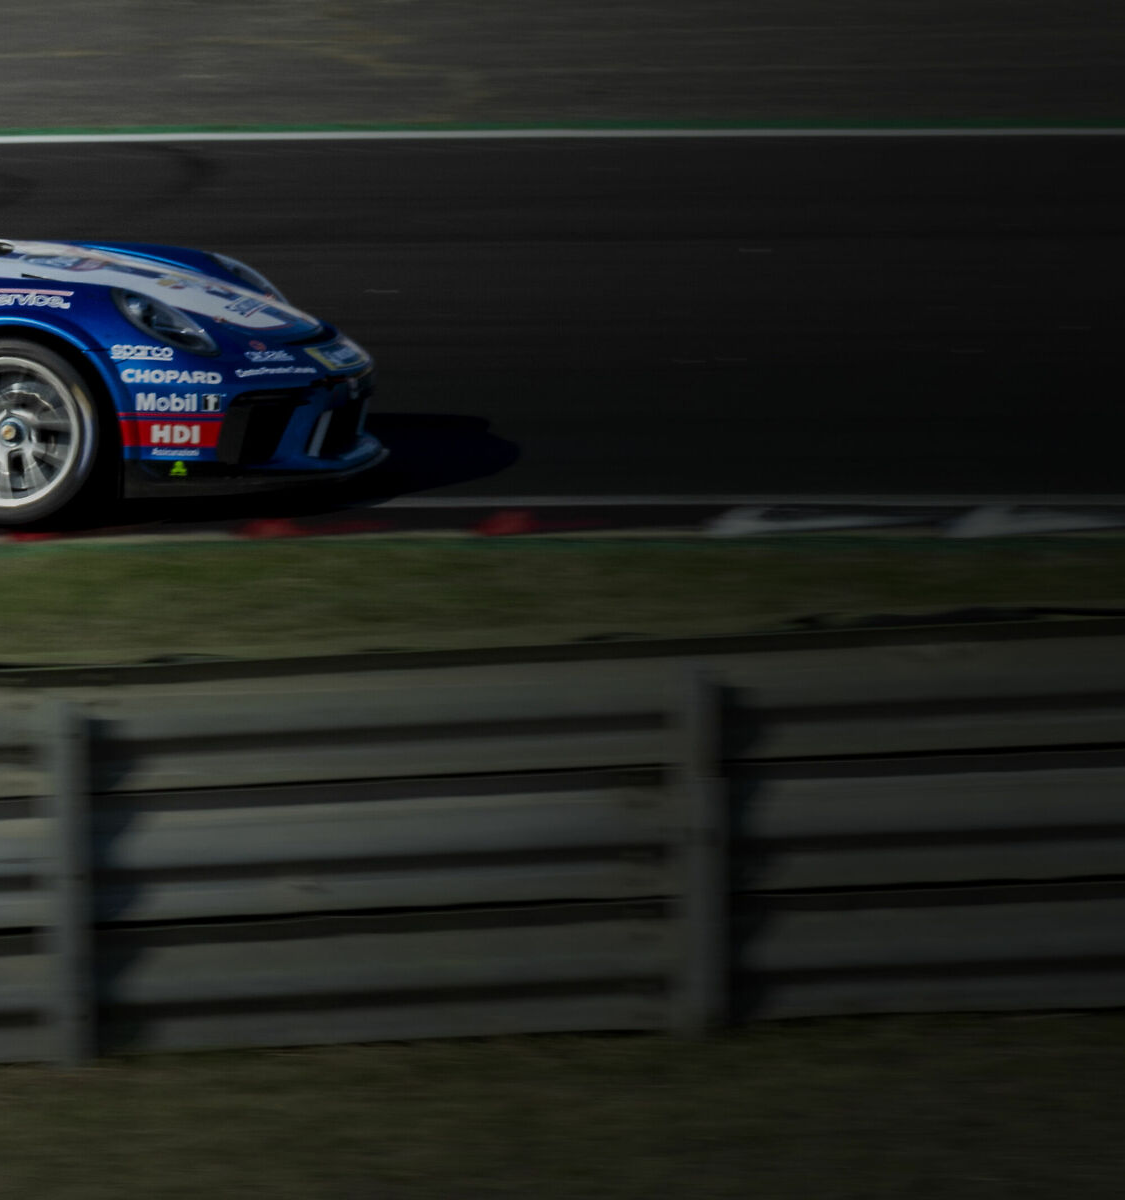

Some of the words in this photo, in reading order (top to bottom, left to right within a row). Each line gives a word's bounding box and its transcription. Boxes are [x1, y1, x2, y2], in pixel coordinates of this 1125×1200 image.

[110, 344, 174, 361] sparco
[120, 368, 223, 385] CHOPARD
[136, 392, 198, 412] Mobil
[150, 424, 201, 445] HDI
